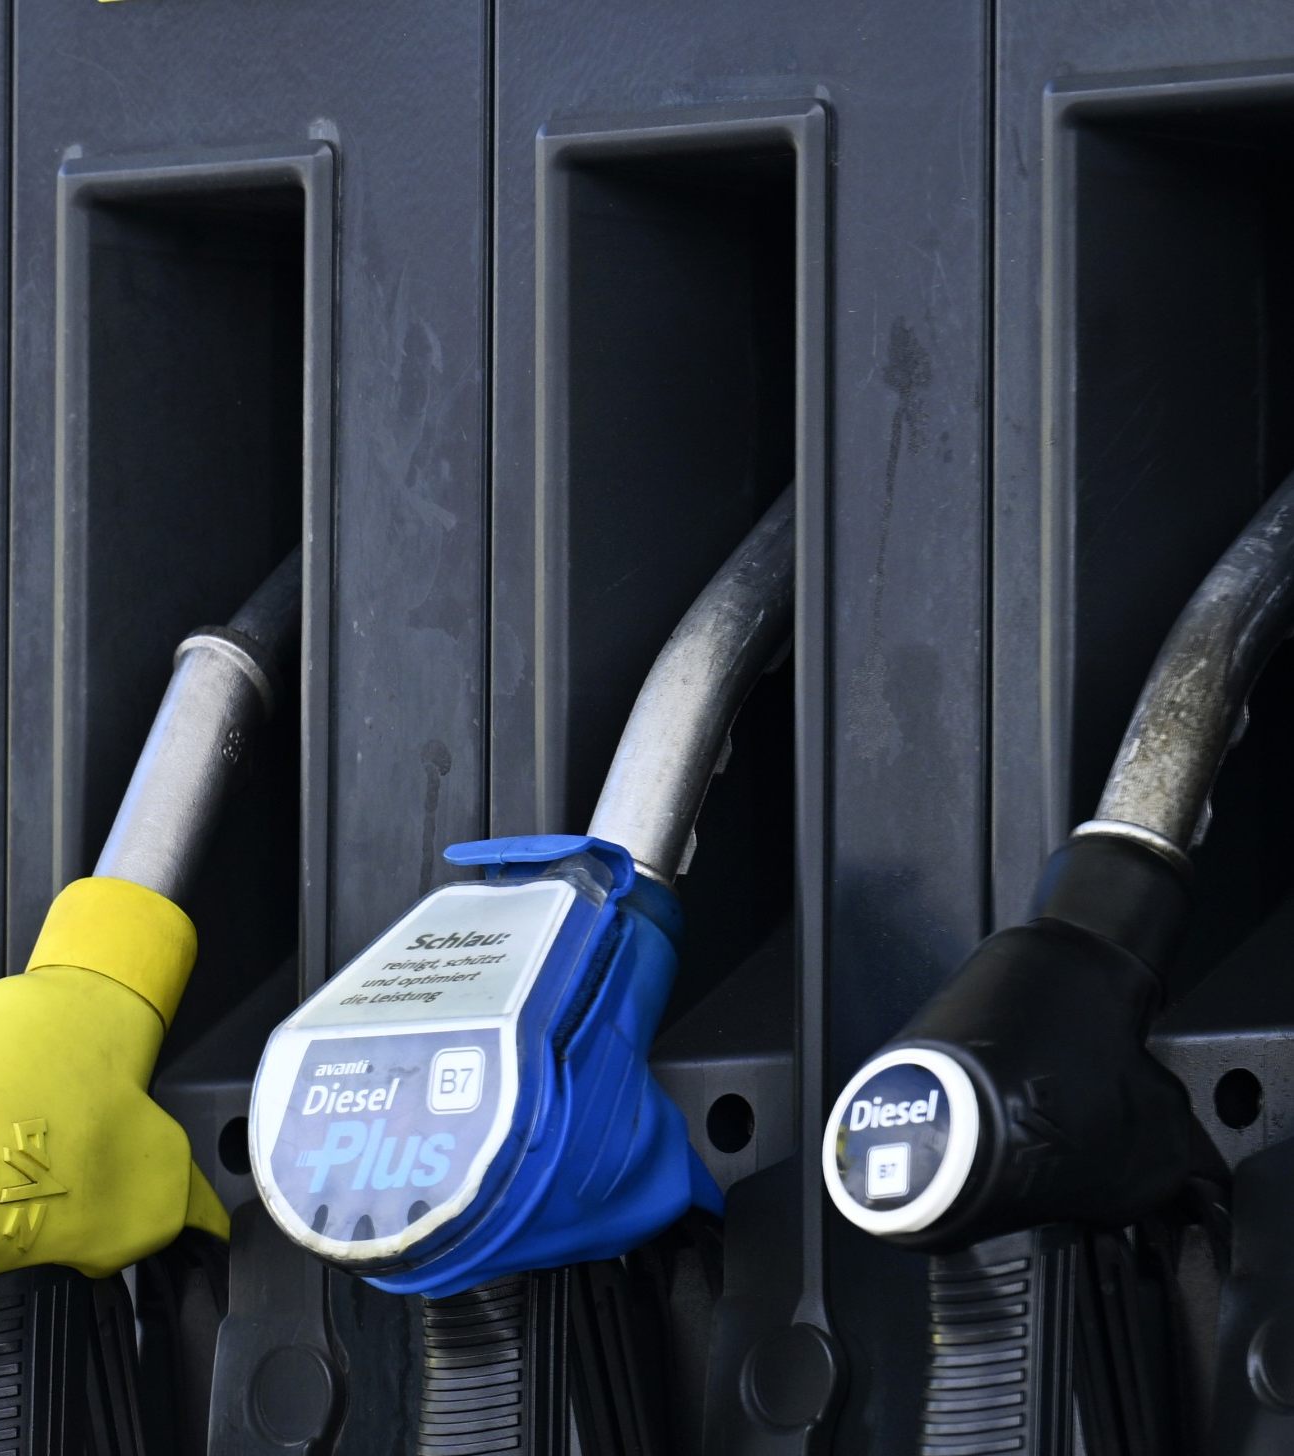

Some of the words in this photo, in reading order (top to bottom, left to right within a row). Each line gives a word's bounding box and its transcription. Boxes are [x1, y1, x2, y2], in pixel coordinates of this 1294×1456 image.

[406, 931, 511, 950] Schlau:
[382, 958, 441, 972] reinigt,
[442, 953, 508, 969] schützt
[361, 976, 401, 988] und
[397, 971, 482, 988] optimiert
[339, 994, 369, 1006] die
[368, 991, 444, 1004] Leistung
[314, 1059, 370, 1077] avanti
[439, 1067, 474, 1095] B7
[301, 1077, 402, 1116] Diesel
[849, 1089, 939, 1131] Diesel
[295, 1117, 456, 1194] Plus
